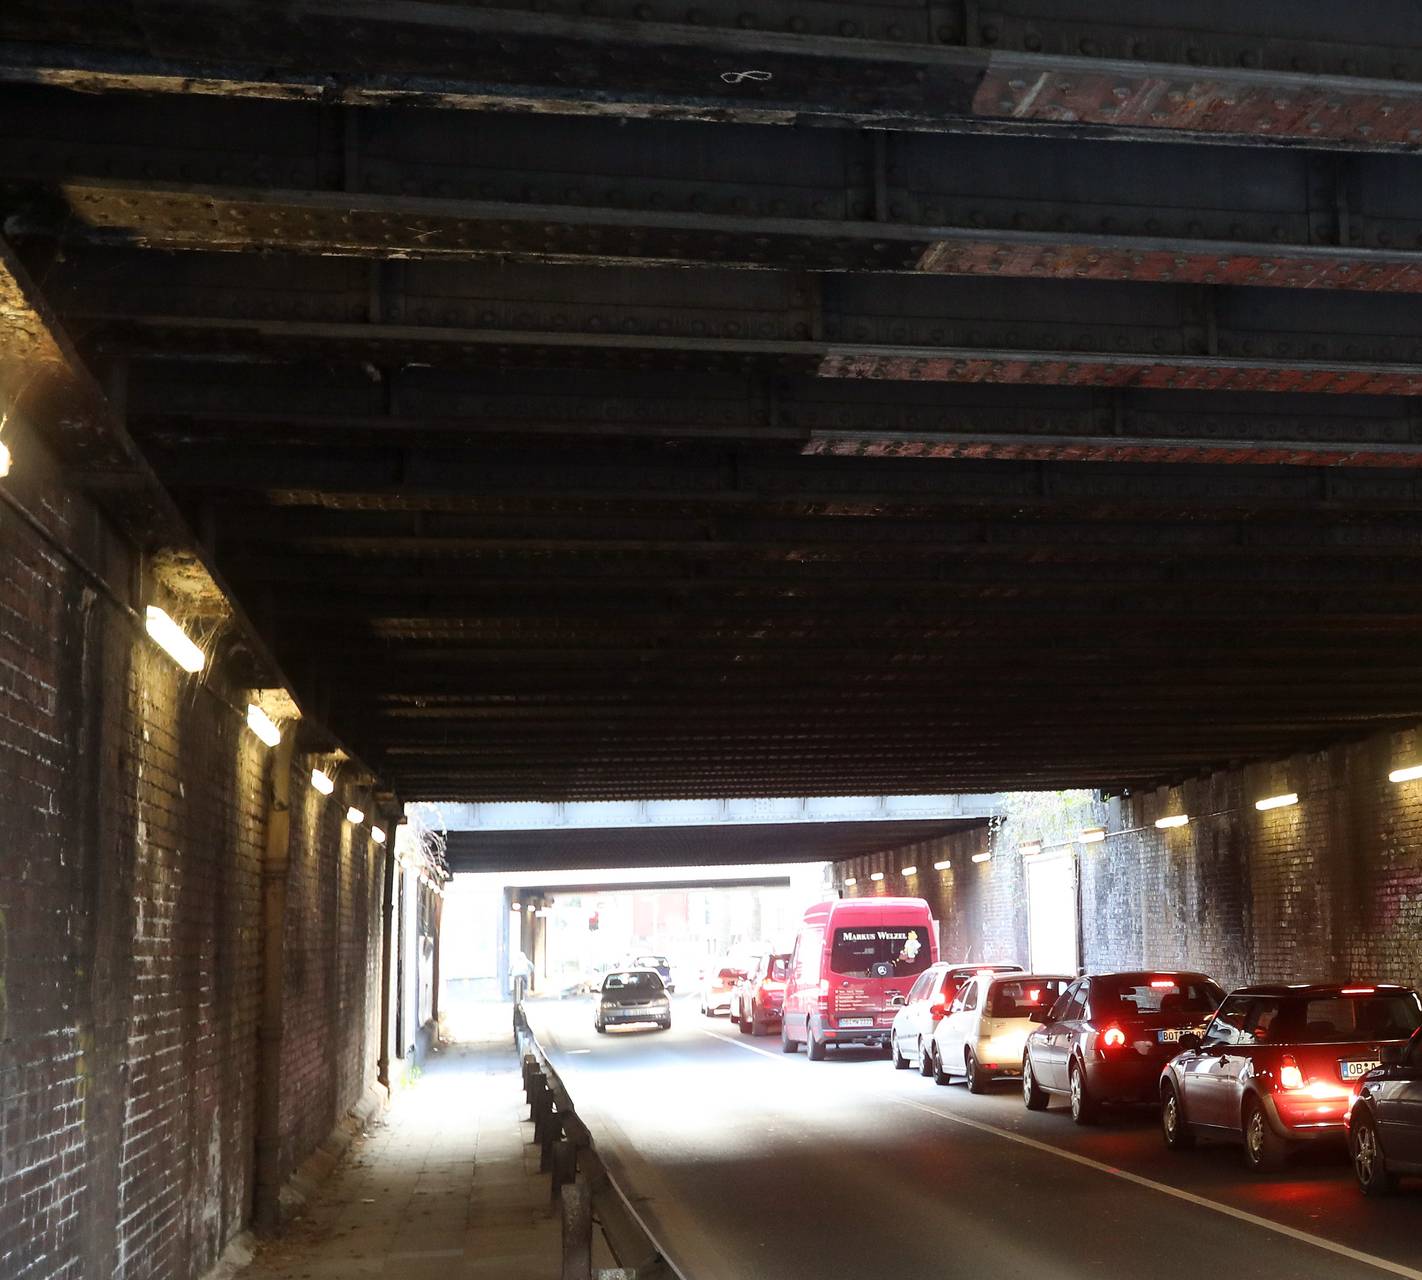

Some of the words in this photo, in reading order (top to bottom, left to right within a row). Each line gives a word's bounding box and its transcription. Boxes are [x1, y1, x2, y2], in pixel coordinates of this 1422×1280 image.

[843, 932, 876, 941] MARKUS
[877, 931, 907, 940] WELZEL
[1163, 1031, 1179, 1041] BOT
[1349, 1063, 1363, 1075] OB
